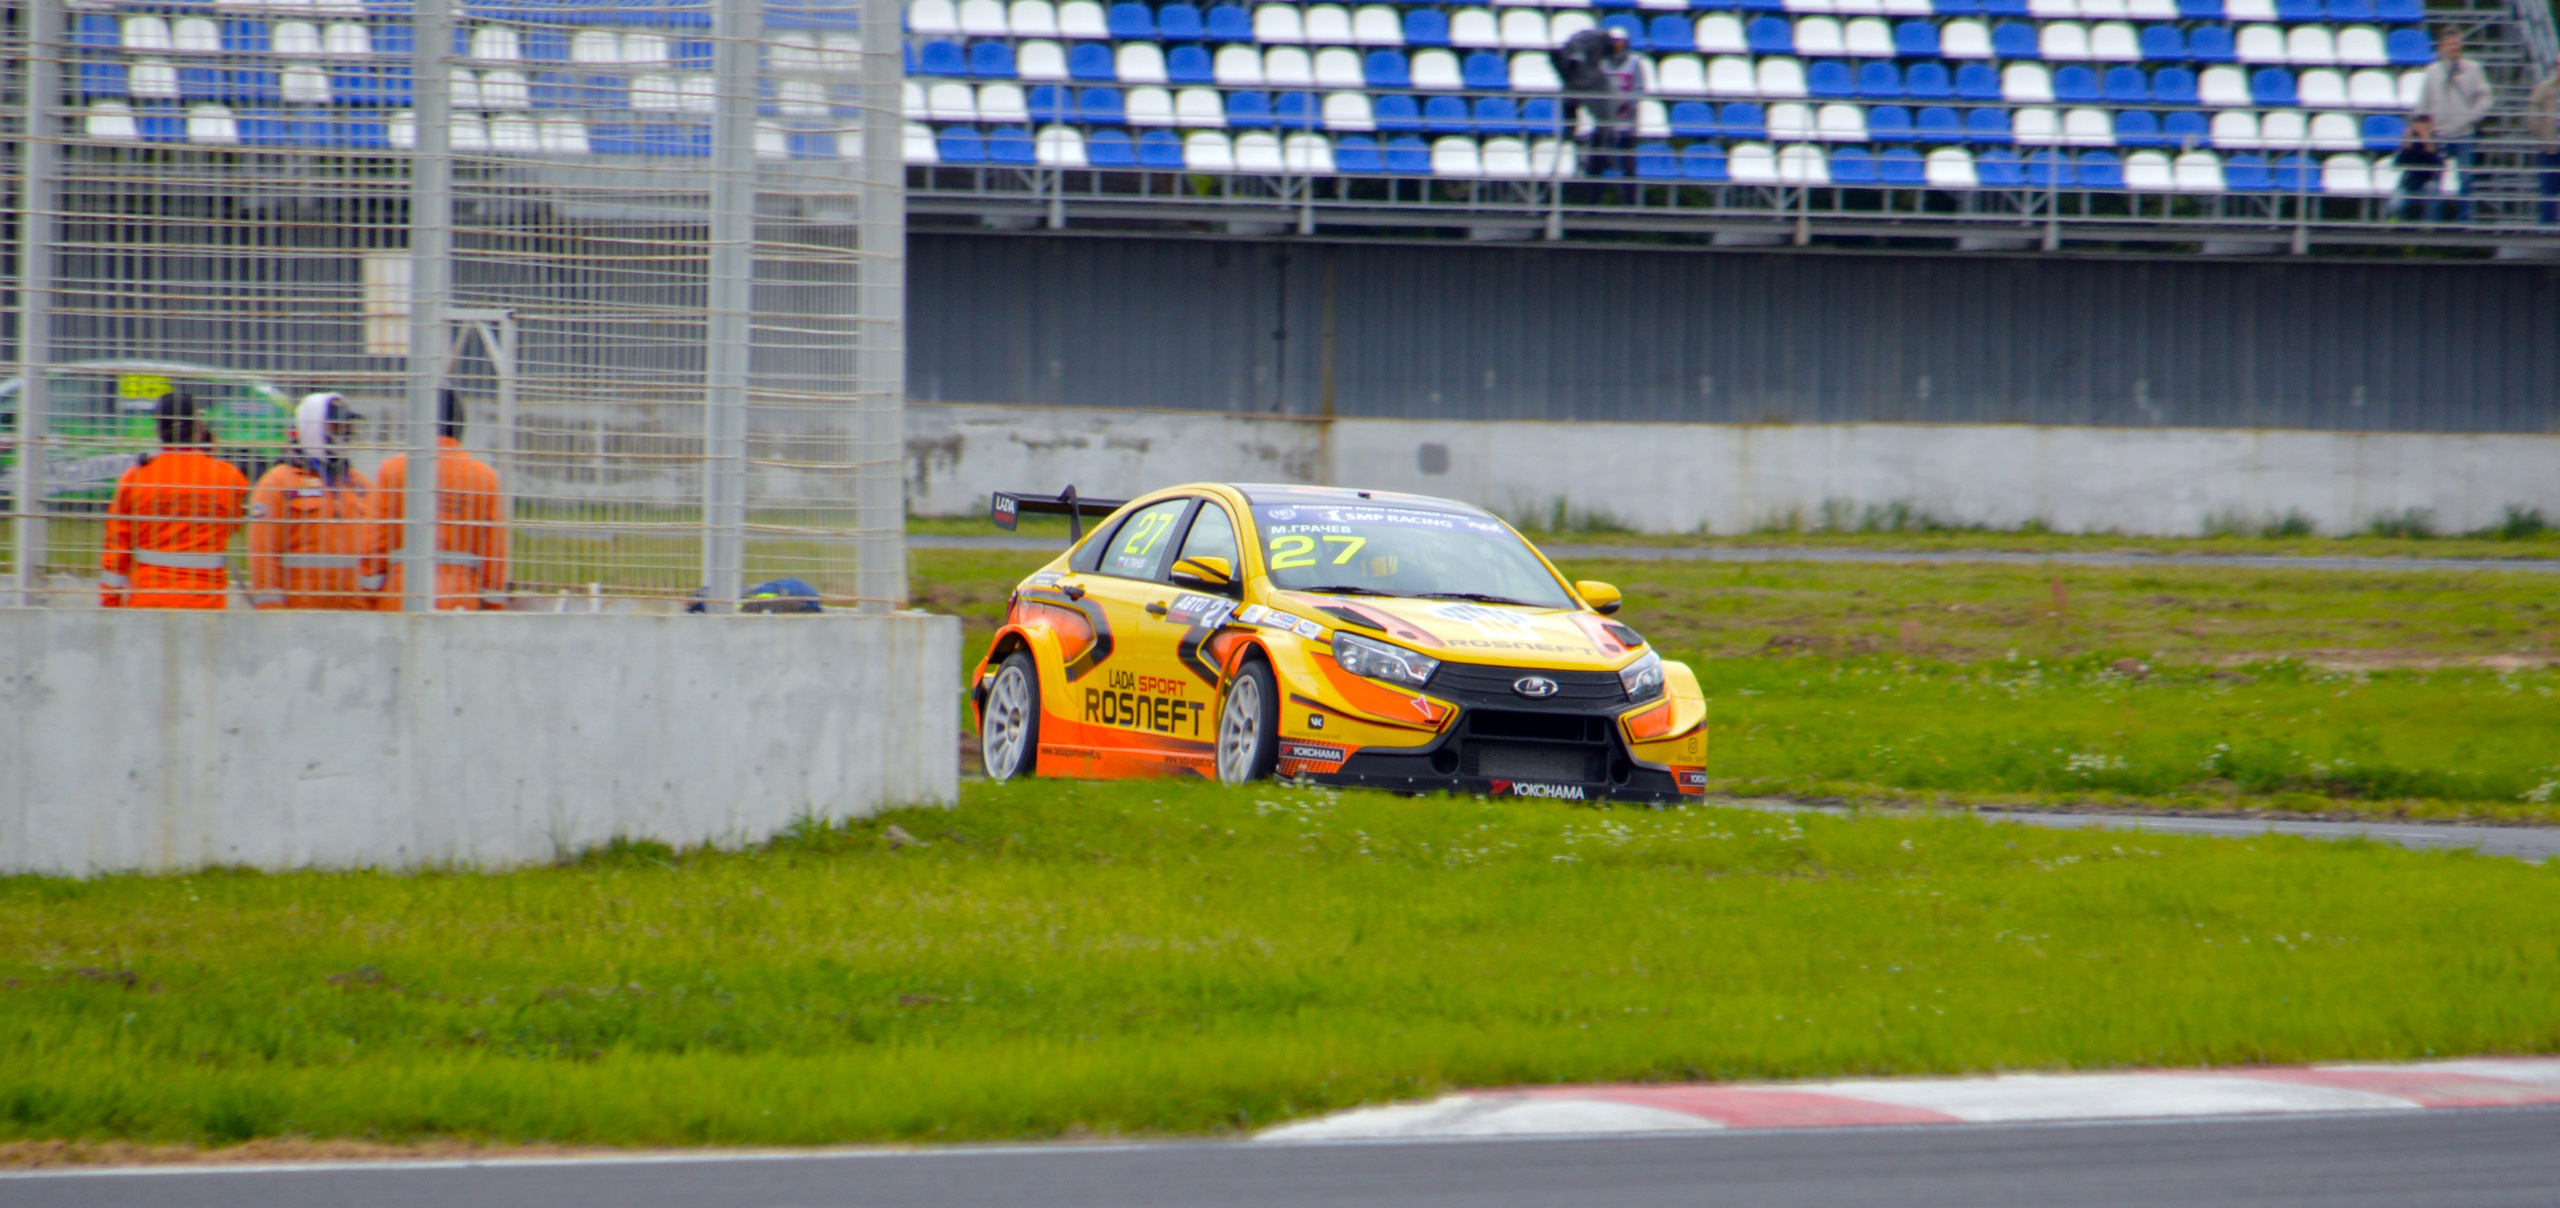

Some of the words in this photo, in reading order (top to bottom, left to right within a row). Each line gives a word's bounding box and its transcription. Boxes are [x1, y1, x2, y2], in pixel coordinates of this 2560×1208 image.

[996, 496, 1015, 514] LADA
[1345, 512, 1384, 521] SMP
[1387, 513, 1453, 528] RACING
[1123, 511, 1174, 555] 27
[1271, 525, 1351, 534] М.ГРАЧЕВ
[1269, 535, 1366, 570] 27
[1174, 595, 1211, 612] АВТО
[1200, 599, 1240, 629] 27
[1447, 639, 1593, 655] ROSNEFT
[1108, 669, 1136, 691] LADA
[1139, 675, 1187, 697] SPORT
[1085, 687, 1205, 736] ROSNEFT
[1293, 747, 1341, 760] YOKOHAMA
[1512, 782, 1585, 799] YOKOHAMA
